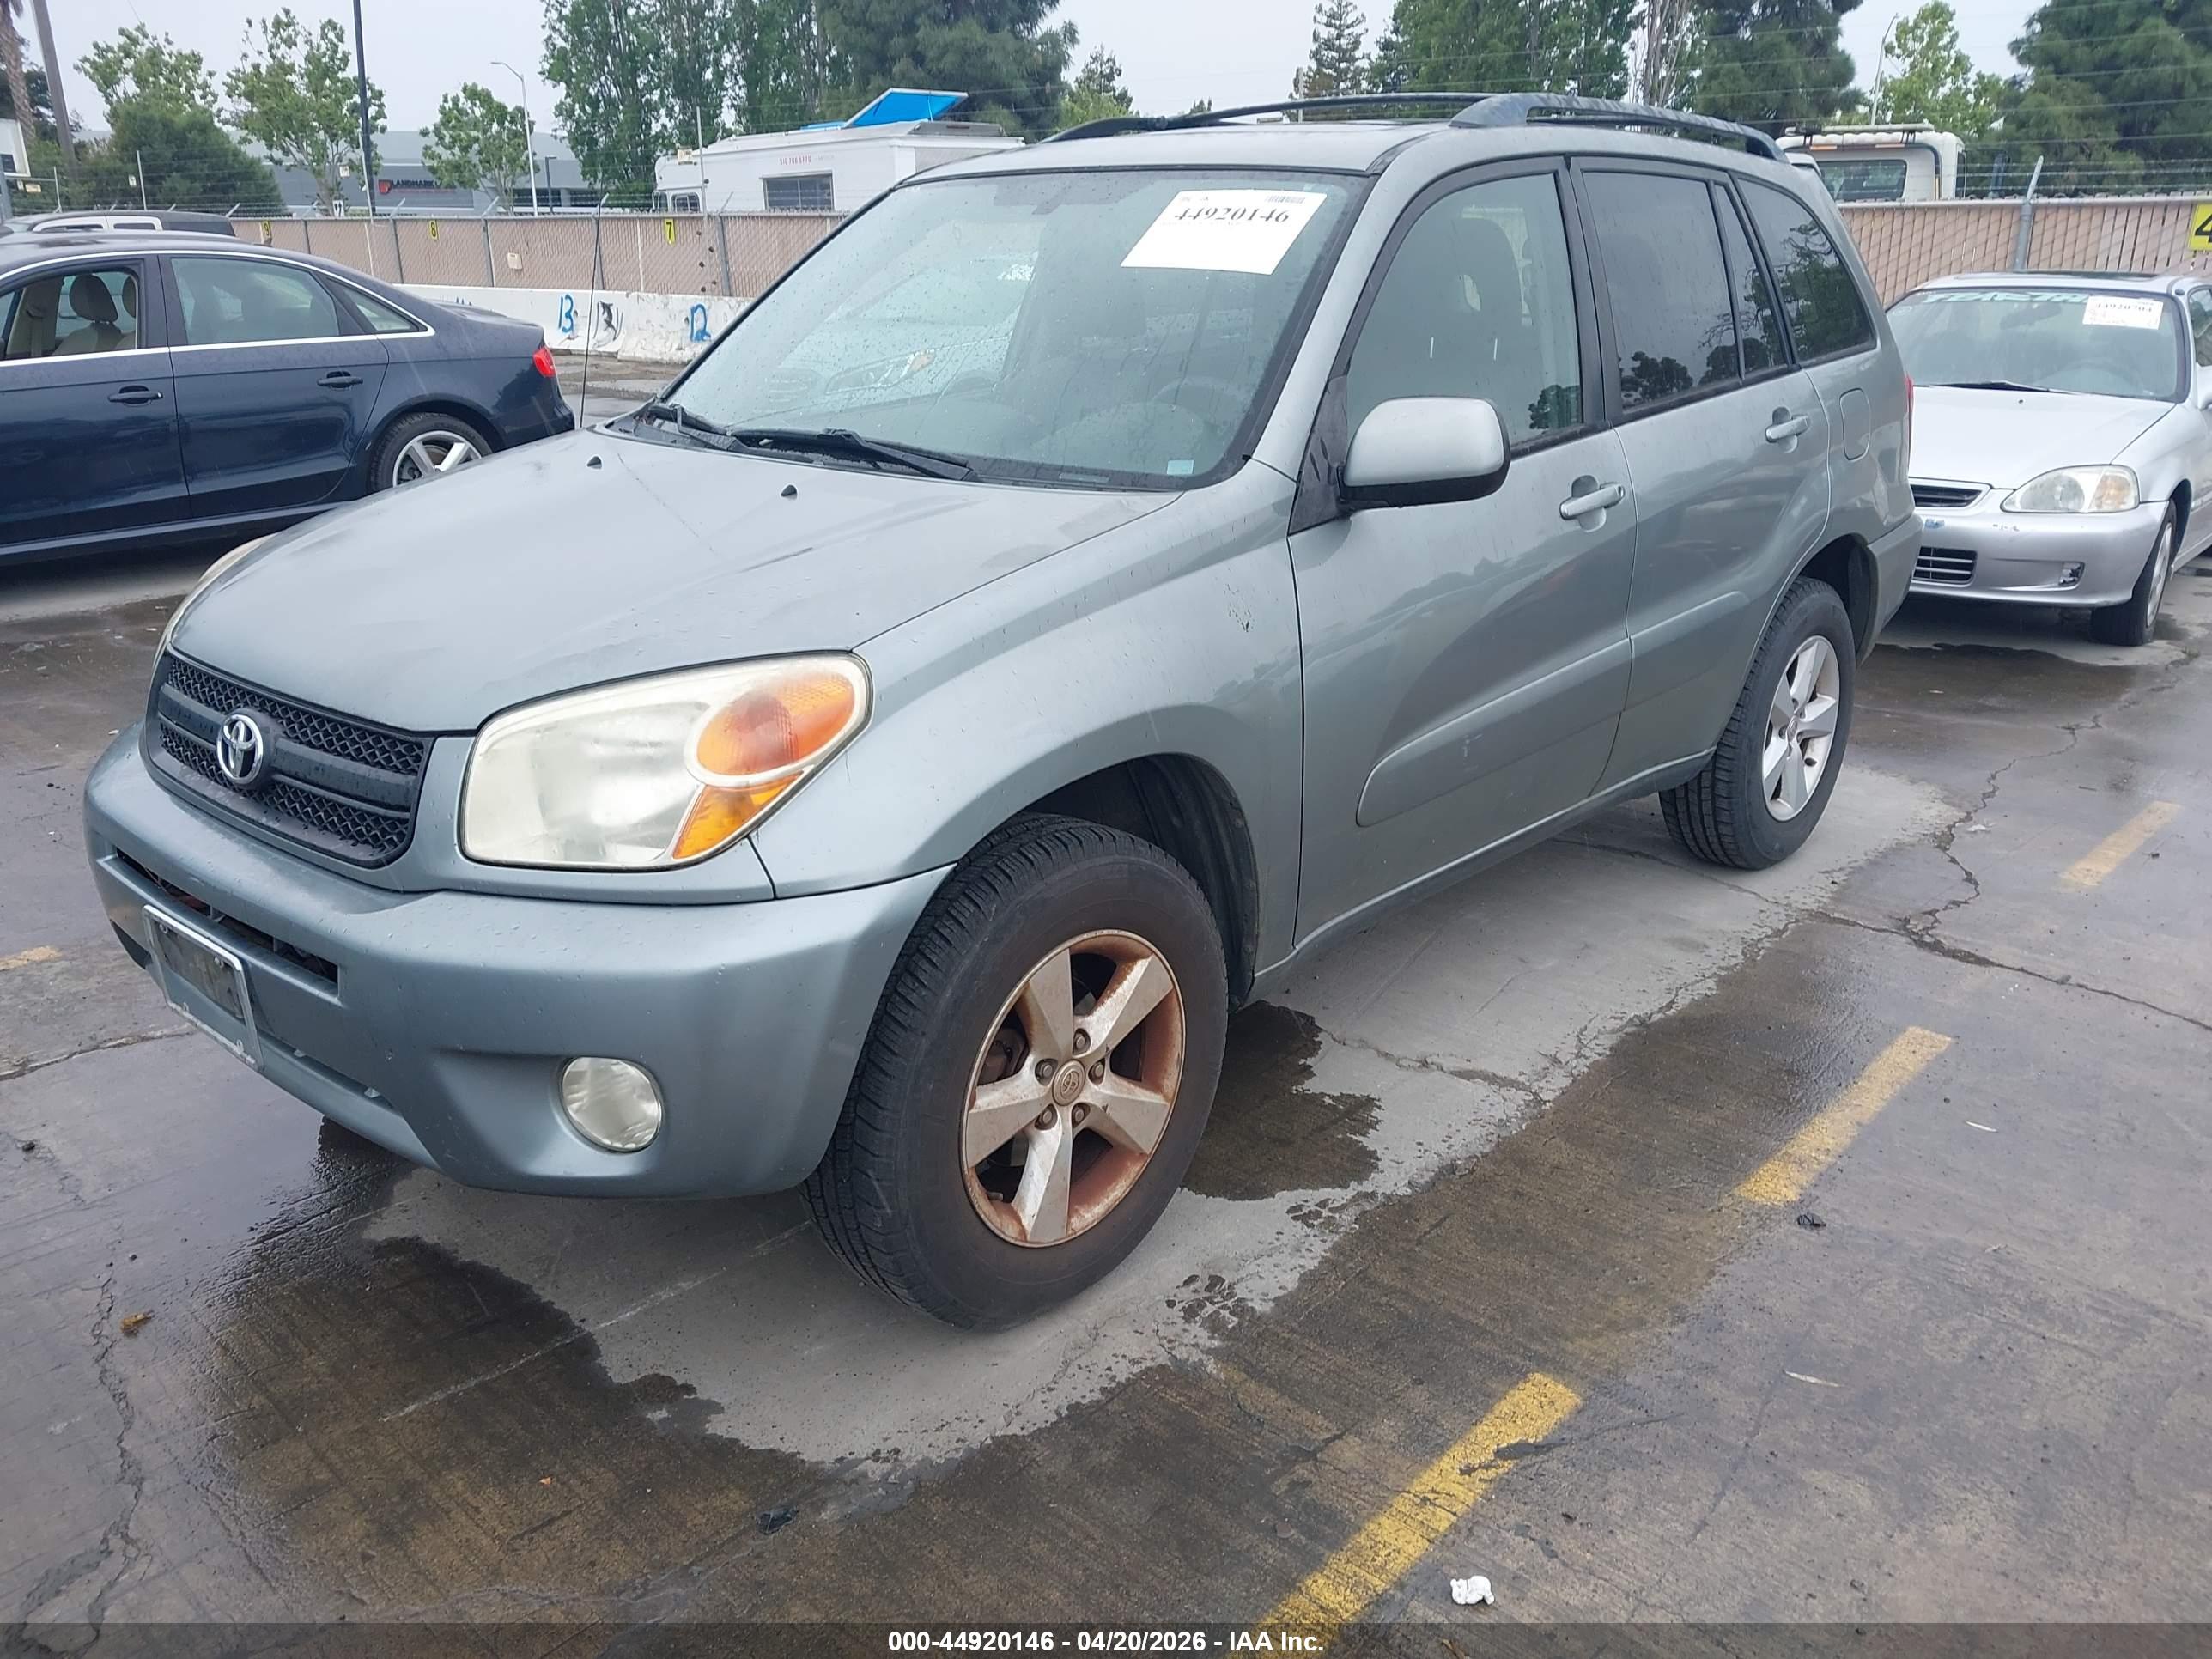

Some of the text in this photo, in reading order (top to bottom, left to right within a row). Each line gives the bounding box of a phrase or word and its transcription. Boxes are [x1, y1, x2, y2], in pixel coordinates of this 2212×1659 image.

[1175, 208, 1289, 222] 44920146
[264, 223, 270, 236] 9
[430, 222, 437, 238] 8
[665, 221, 672, 240] 7
[2194, 213, 2212, 243] 4
